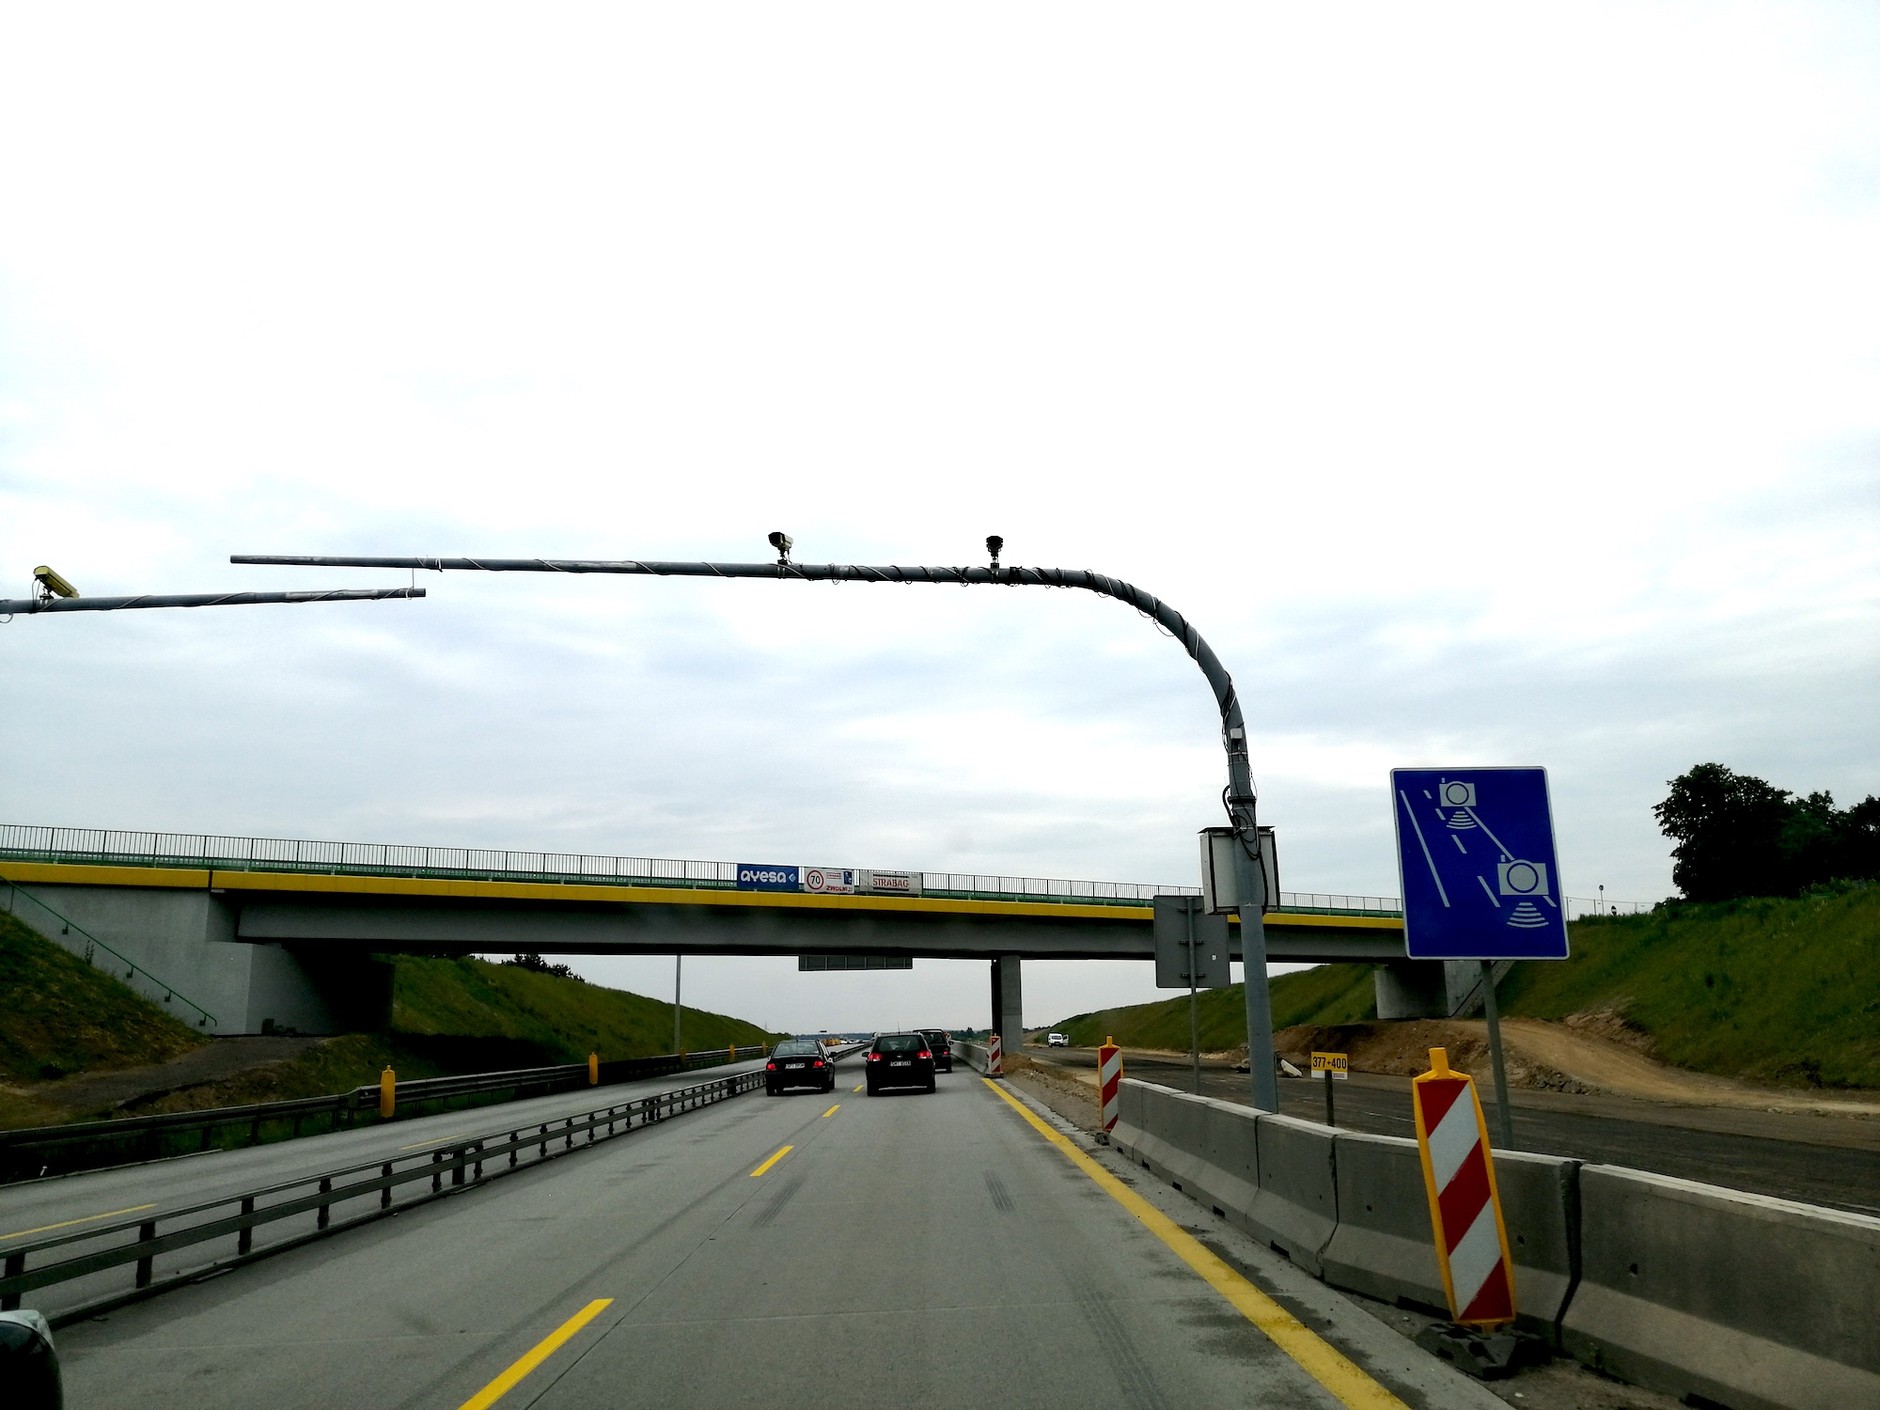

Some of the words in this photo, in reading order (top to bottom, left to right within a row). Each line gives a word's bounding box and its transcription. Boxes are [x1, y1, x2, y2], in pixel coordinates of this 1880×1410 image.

[740, 870, 787, 883] ayesa
[811, 875, 821, 884] 70
[873, 878, 909, 887] STRABAG
